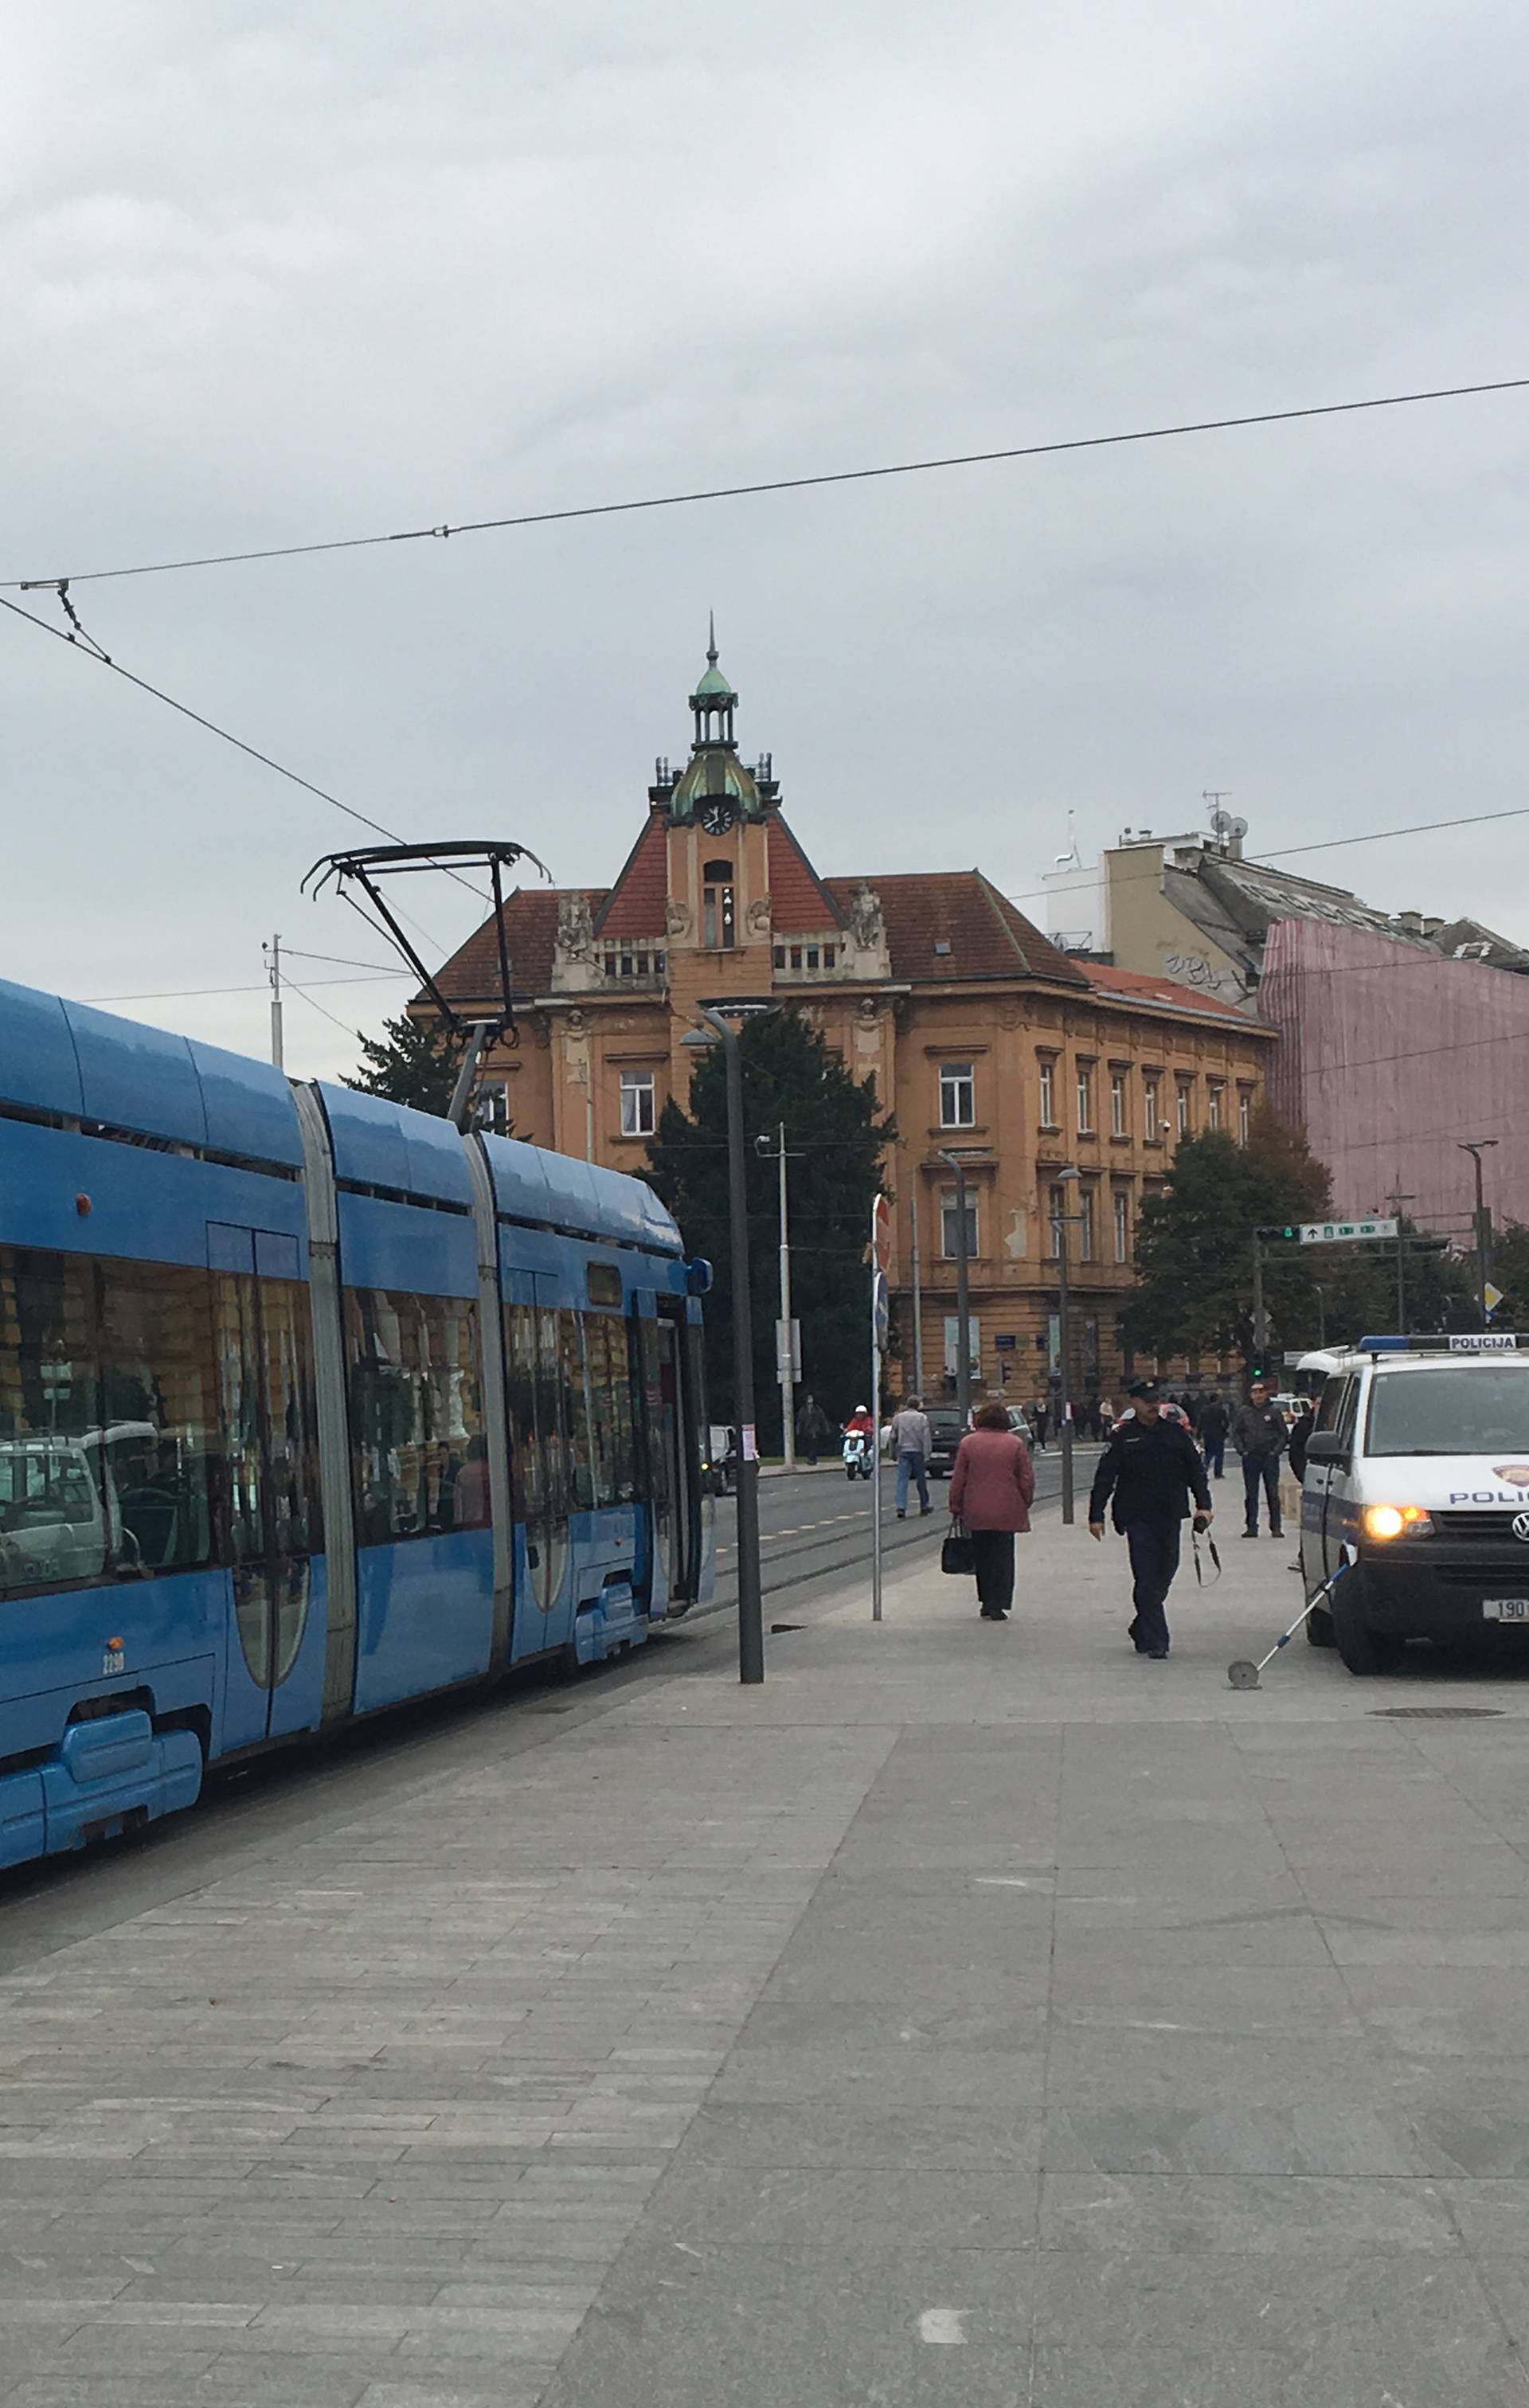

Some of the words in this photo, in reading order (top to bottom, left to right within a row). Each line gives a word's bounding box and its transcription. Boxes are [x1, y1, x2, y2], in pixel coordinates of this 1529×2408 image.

[1451, 1338, 1513, 1348] POLICIJA
[1449, 1491, 1529, 1504] POLI
[1498, 1601, 1524, 1617] 190
